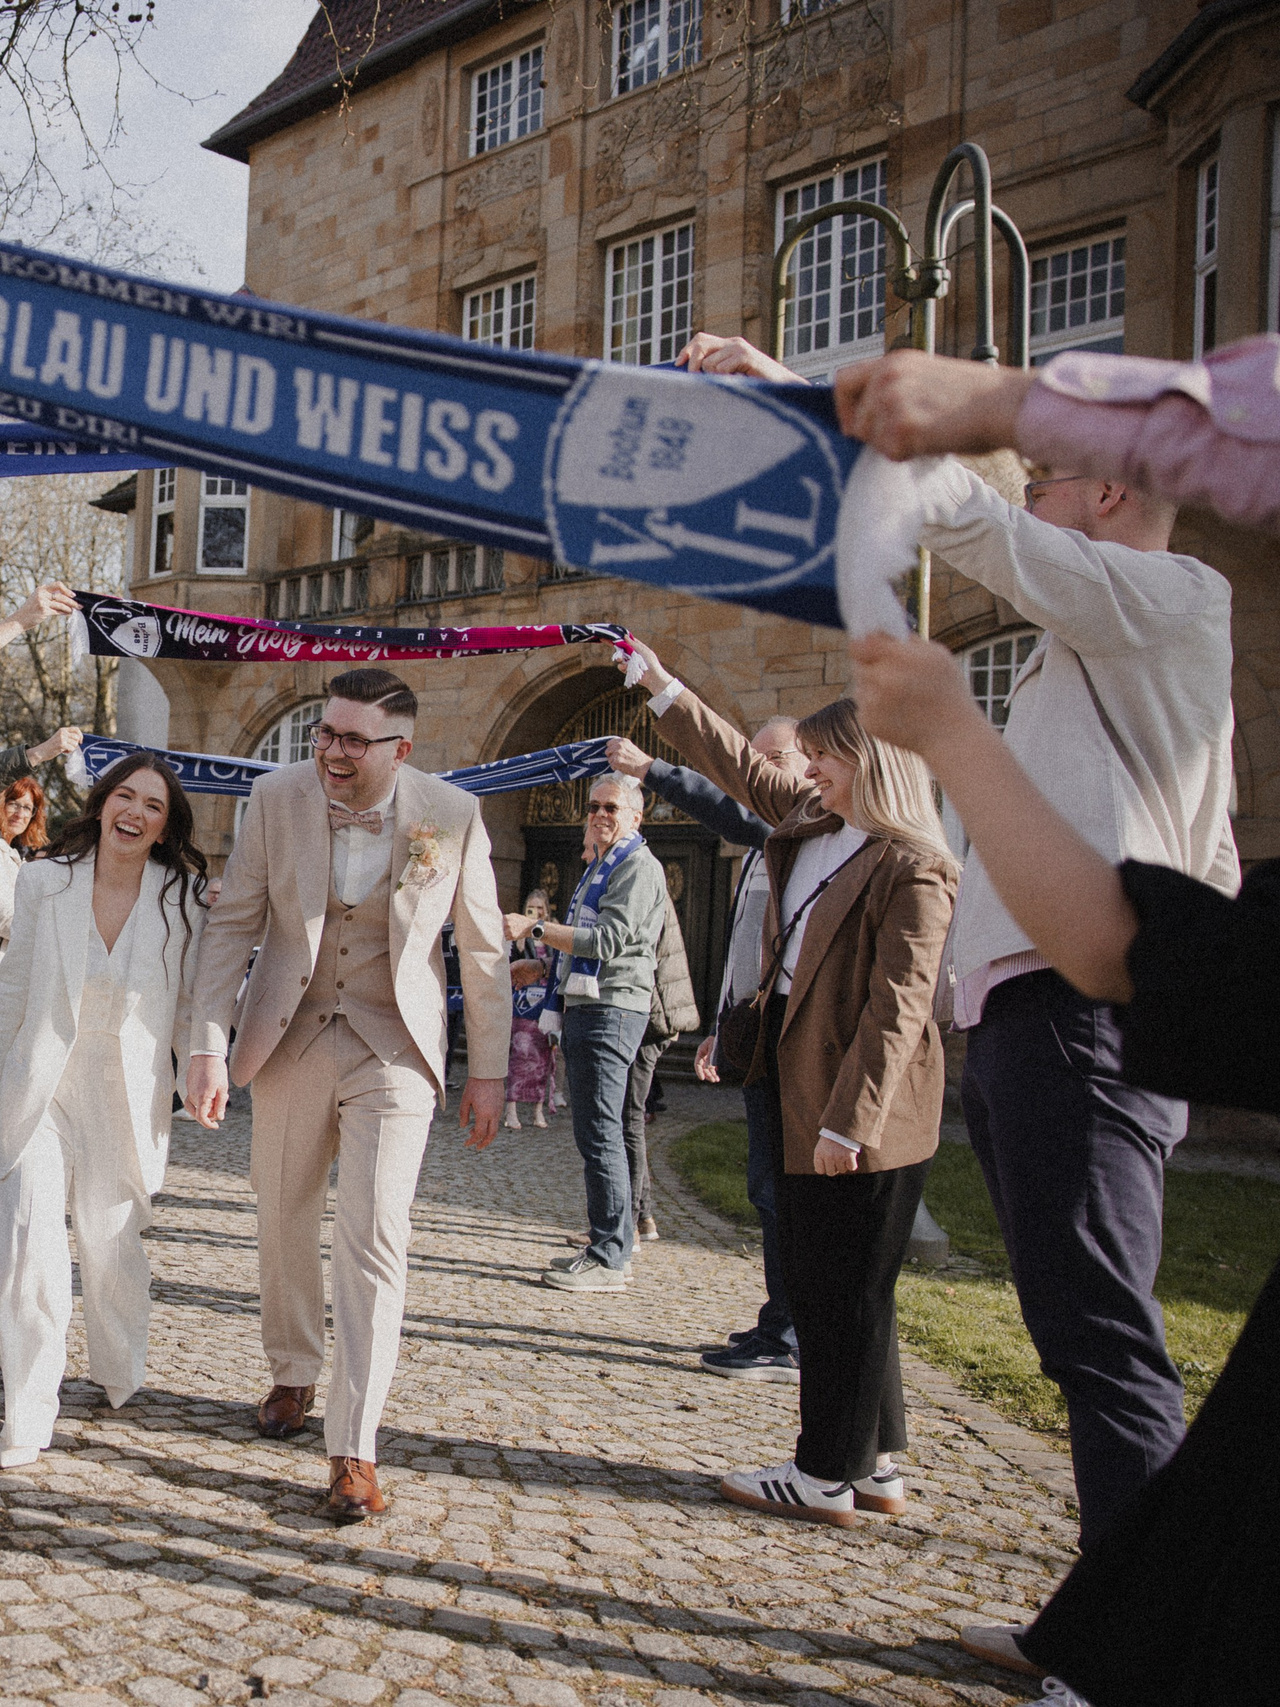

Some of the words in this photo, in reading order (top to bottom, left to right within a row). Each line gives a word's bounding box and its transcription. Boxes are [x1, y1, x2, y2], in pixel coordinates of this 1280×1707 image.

[200, 296, 308, 342] WIR!
[54, 405, 138, 446] DIR!
[143, 332, 281, 438] UND
[292, 366, 521, 494] WEISS
[165, 613, 230, 647] Mein
